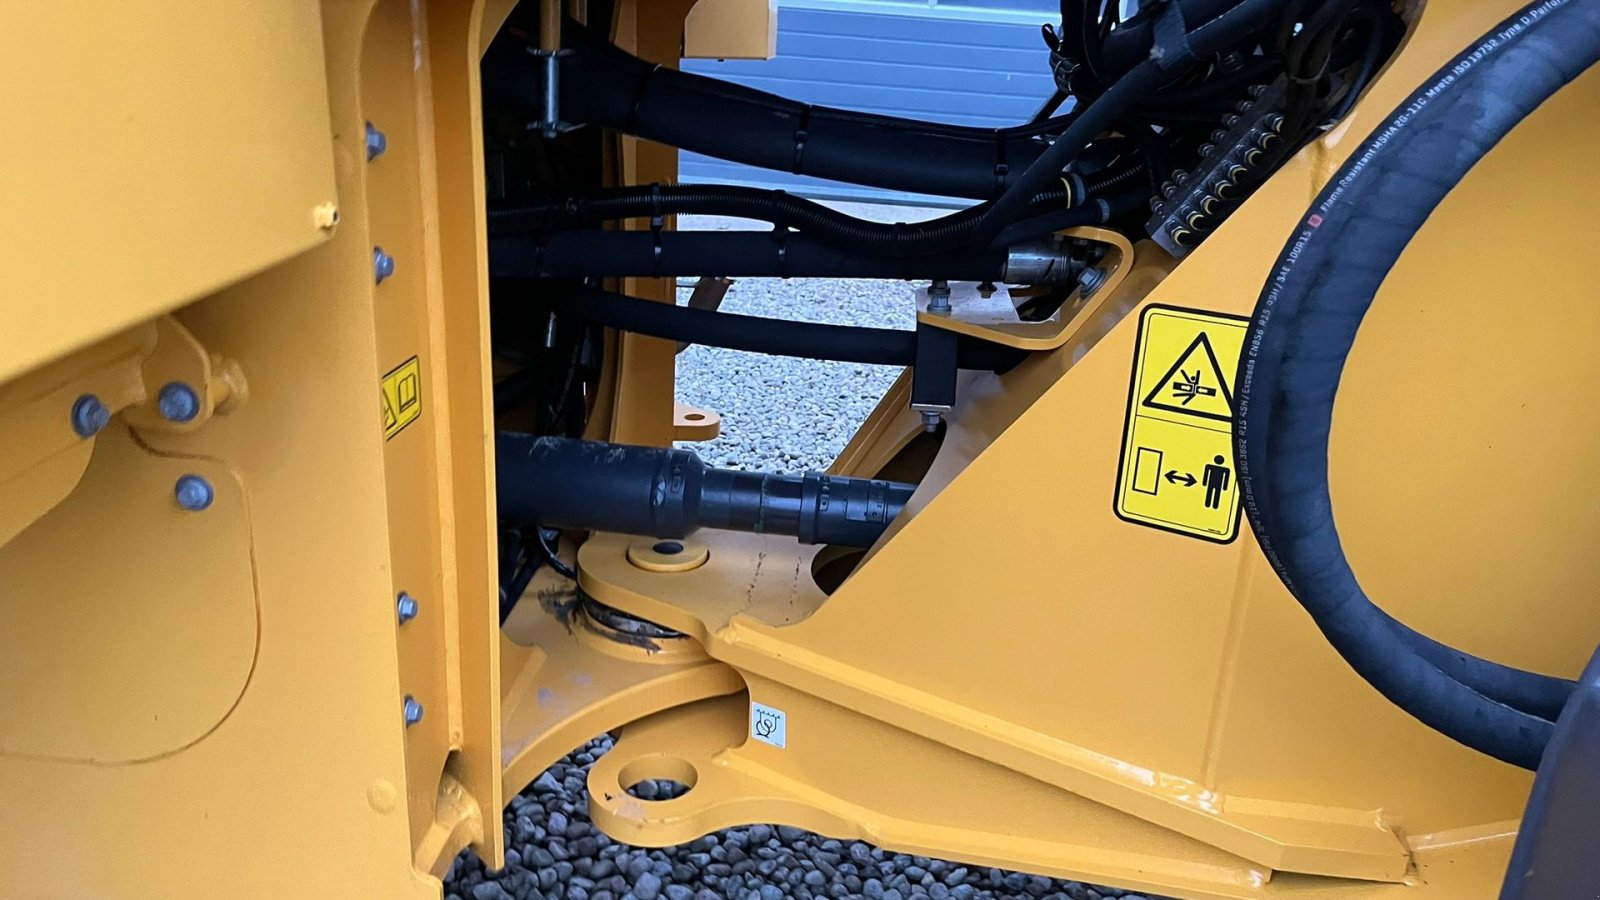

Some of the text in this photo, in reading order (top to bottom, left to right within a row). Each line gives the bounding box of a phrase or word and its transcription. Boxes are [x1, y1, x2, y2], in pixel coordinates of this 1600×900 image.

[1520, 15, 1531, 25] D
[1497, 23, 1521, 41] Type
[1467, 38, 1499, 63] 18752
[1452, 60, 1471, 76] ISO
[1424, 74, 1455, 98] Meets
[1393, 97, 1427, 127] 2G-11C
[1371, 126, 1398, 149] MSHA
[1338, 148, 1376, 188] Resistant
[1319, 186, 1344, 212] Flame
[1286, 230, 1313, 263] 100R15
[1276, 265, 1292, 283] SAE
[1258, 308, 1272, 327] R15
[1248, 328, 1265, 357] EN856
[1241, 359, 1256, 394] Exceeds
[1239, 399, 1249, 418] 4SH
[1239, 419, 1248, 437] R15
[1239, 438, 1248, 461] 3862
[1240, 461, 1250, 475] ISO
